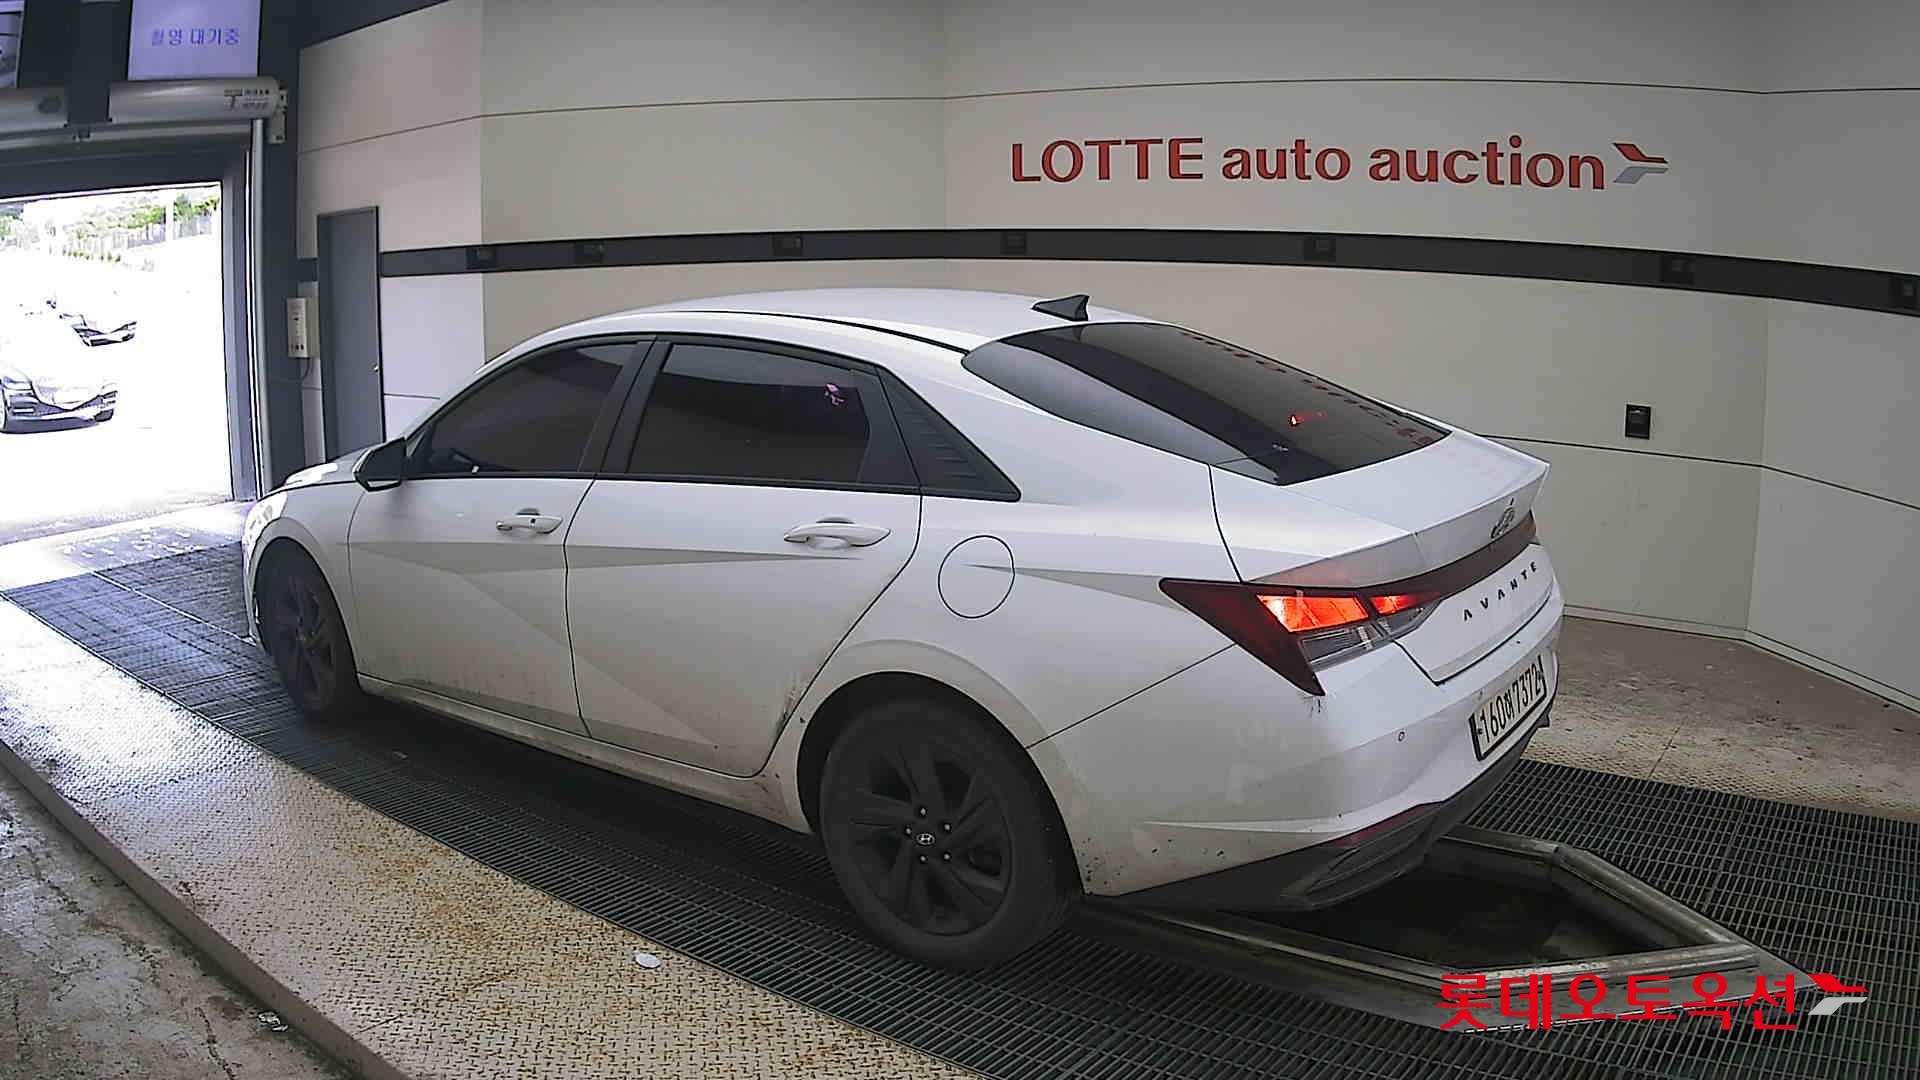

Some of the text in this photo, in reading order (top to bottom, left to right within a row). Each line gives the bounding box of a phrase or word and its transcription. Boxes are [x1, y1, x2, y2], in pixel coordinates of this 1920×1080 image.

[190, 27, 240, 46] 대기중
[1012, 135, 1606, 190] LOTTE auto auction
[1463, 561, 1537, 621] AVANTE
[1512, 664, 1541, 713] 7372
